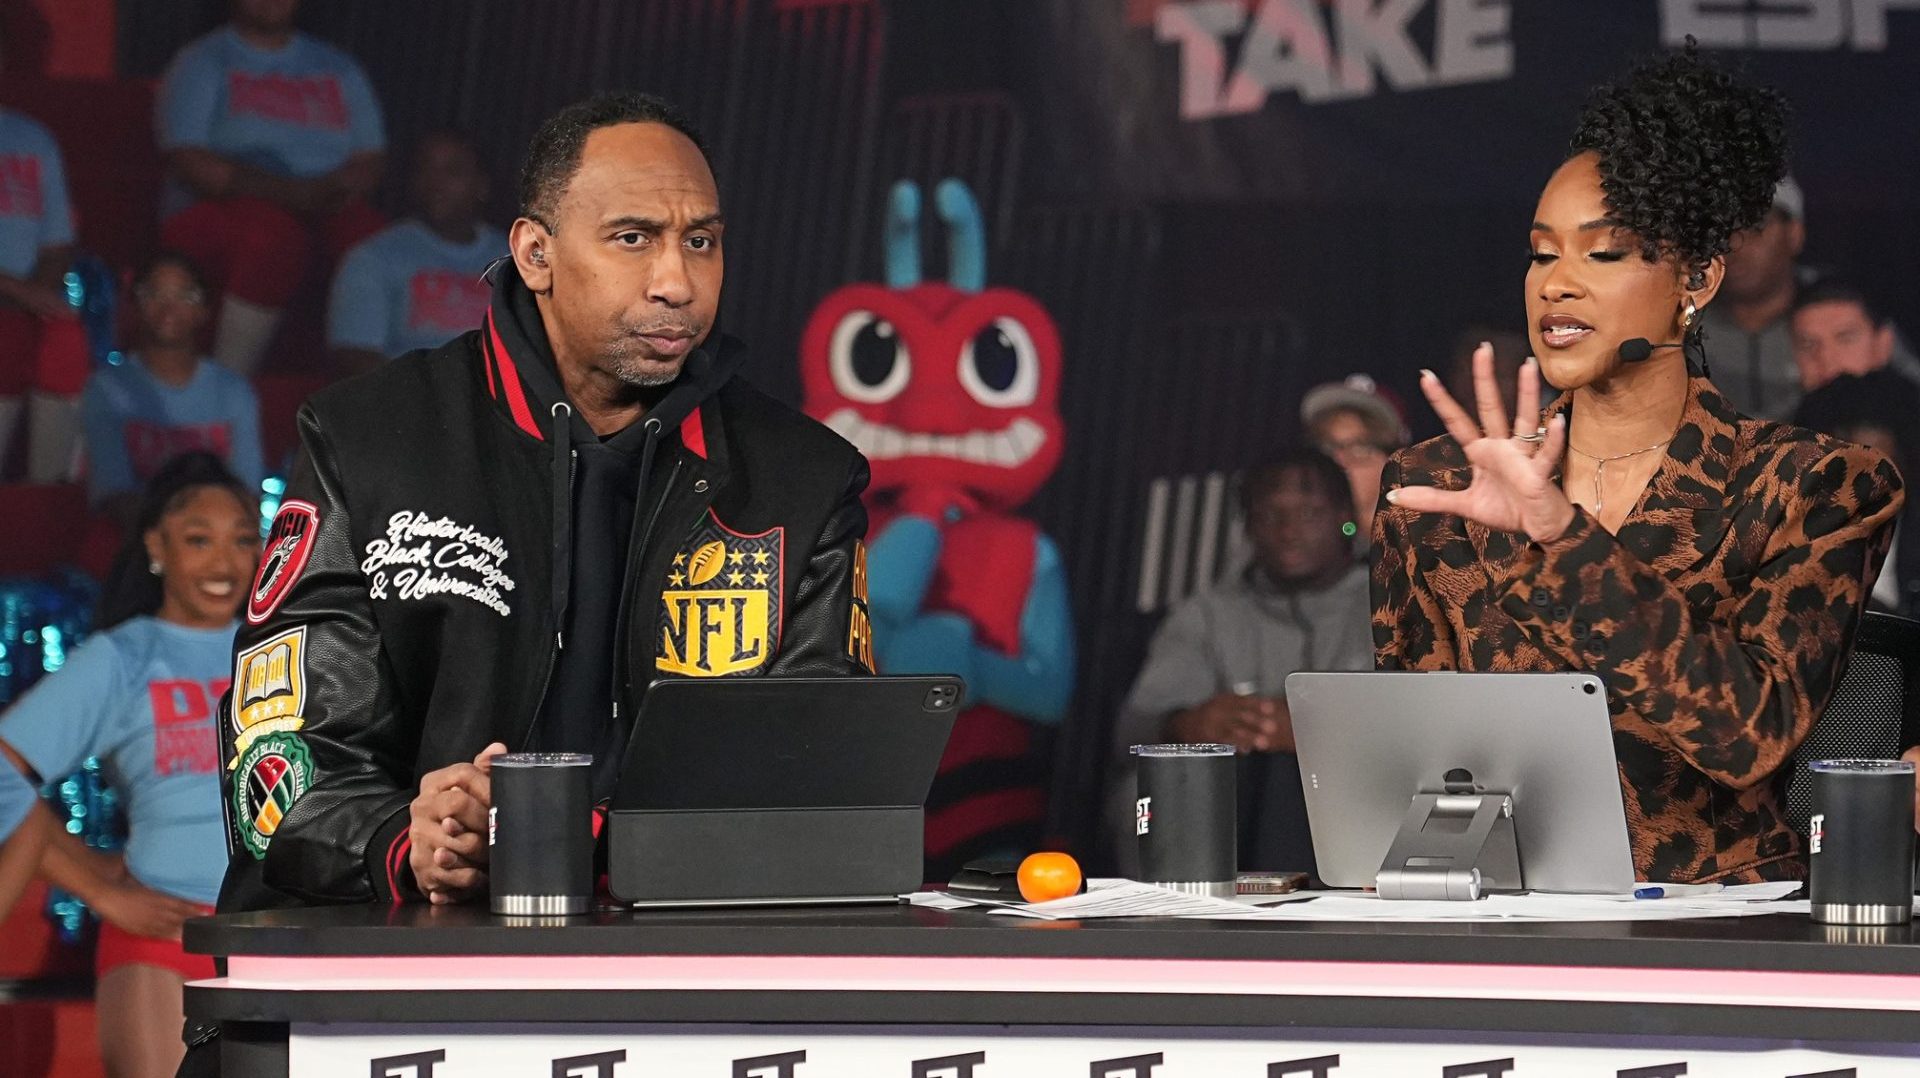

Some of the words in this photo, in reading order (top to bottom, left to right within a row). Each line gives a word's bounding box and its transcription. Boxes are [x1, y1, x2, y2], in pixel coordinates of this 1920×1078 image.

[1154, 0, 1514, 121] TAKE
[361, 539, 432, 576] Black
[434, 542, 516, 592] Colleges
[386, 510, 508, 566] Historically
[370, 571, 390, 601] &
[393, 568, 512, 616] Universities
[657, 597, 761, 671] NFL
[238, 748, 261, 824] HISTORICALLY
[259, 741, 287, 757] BLACK
